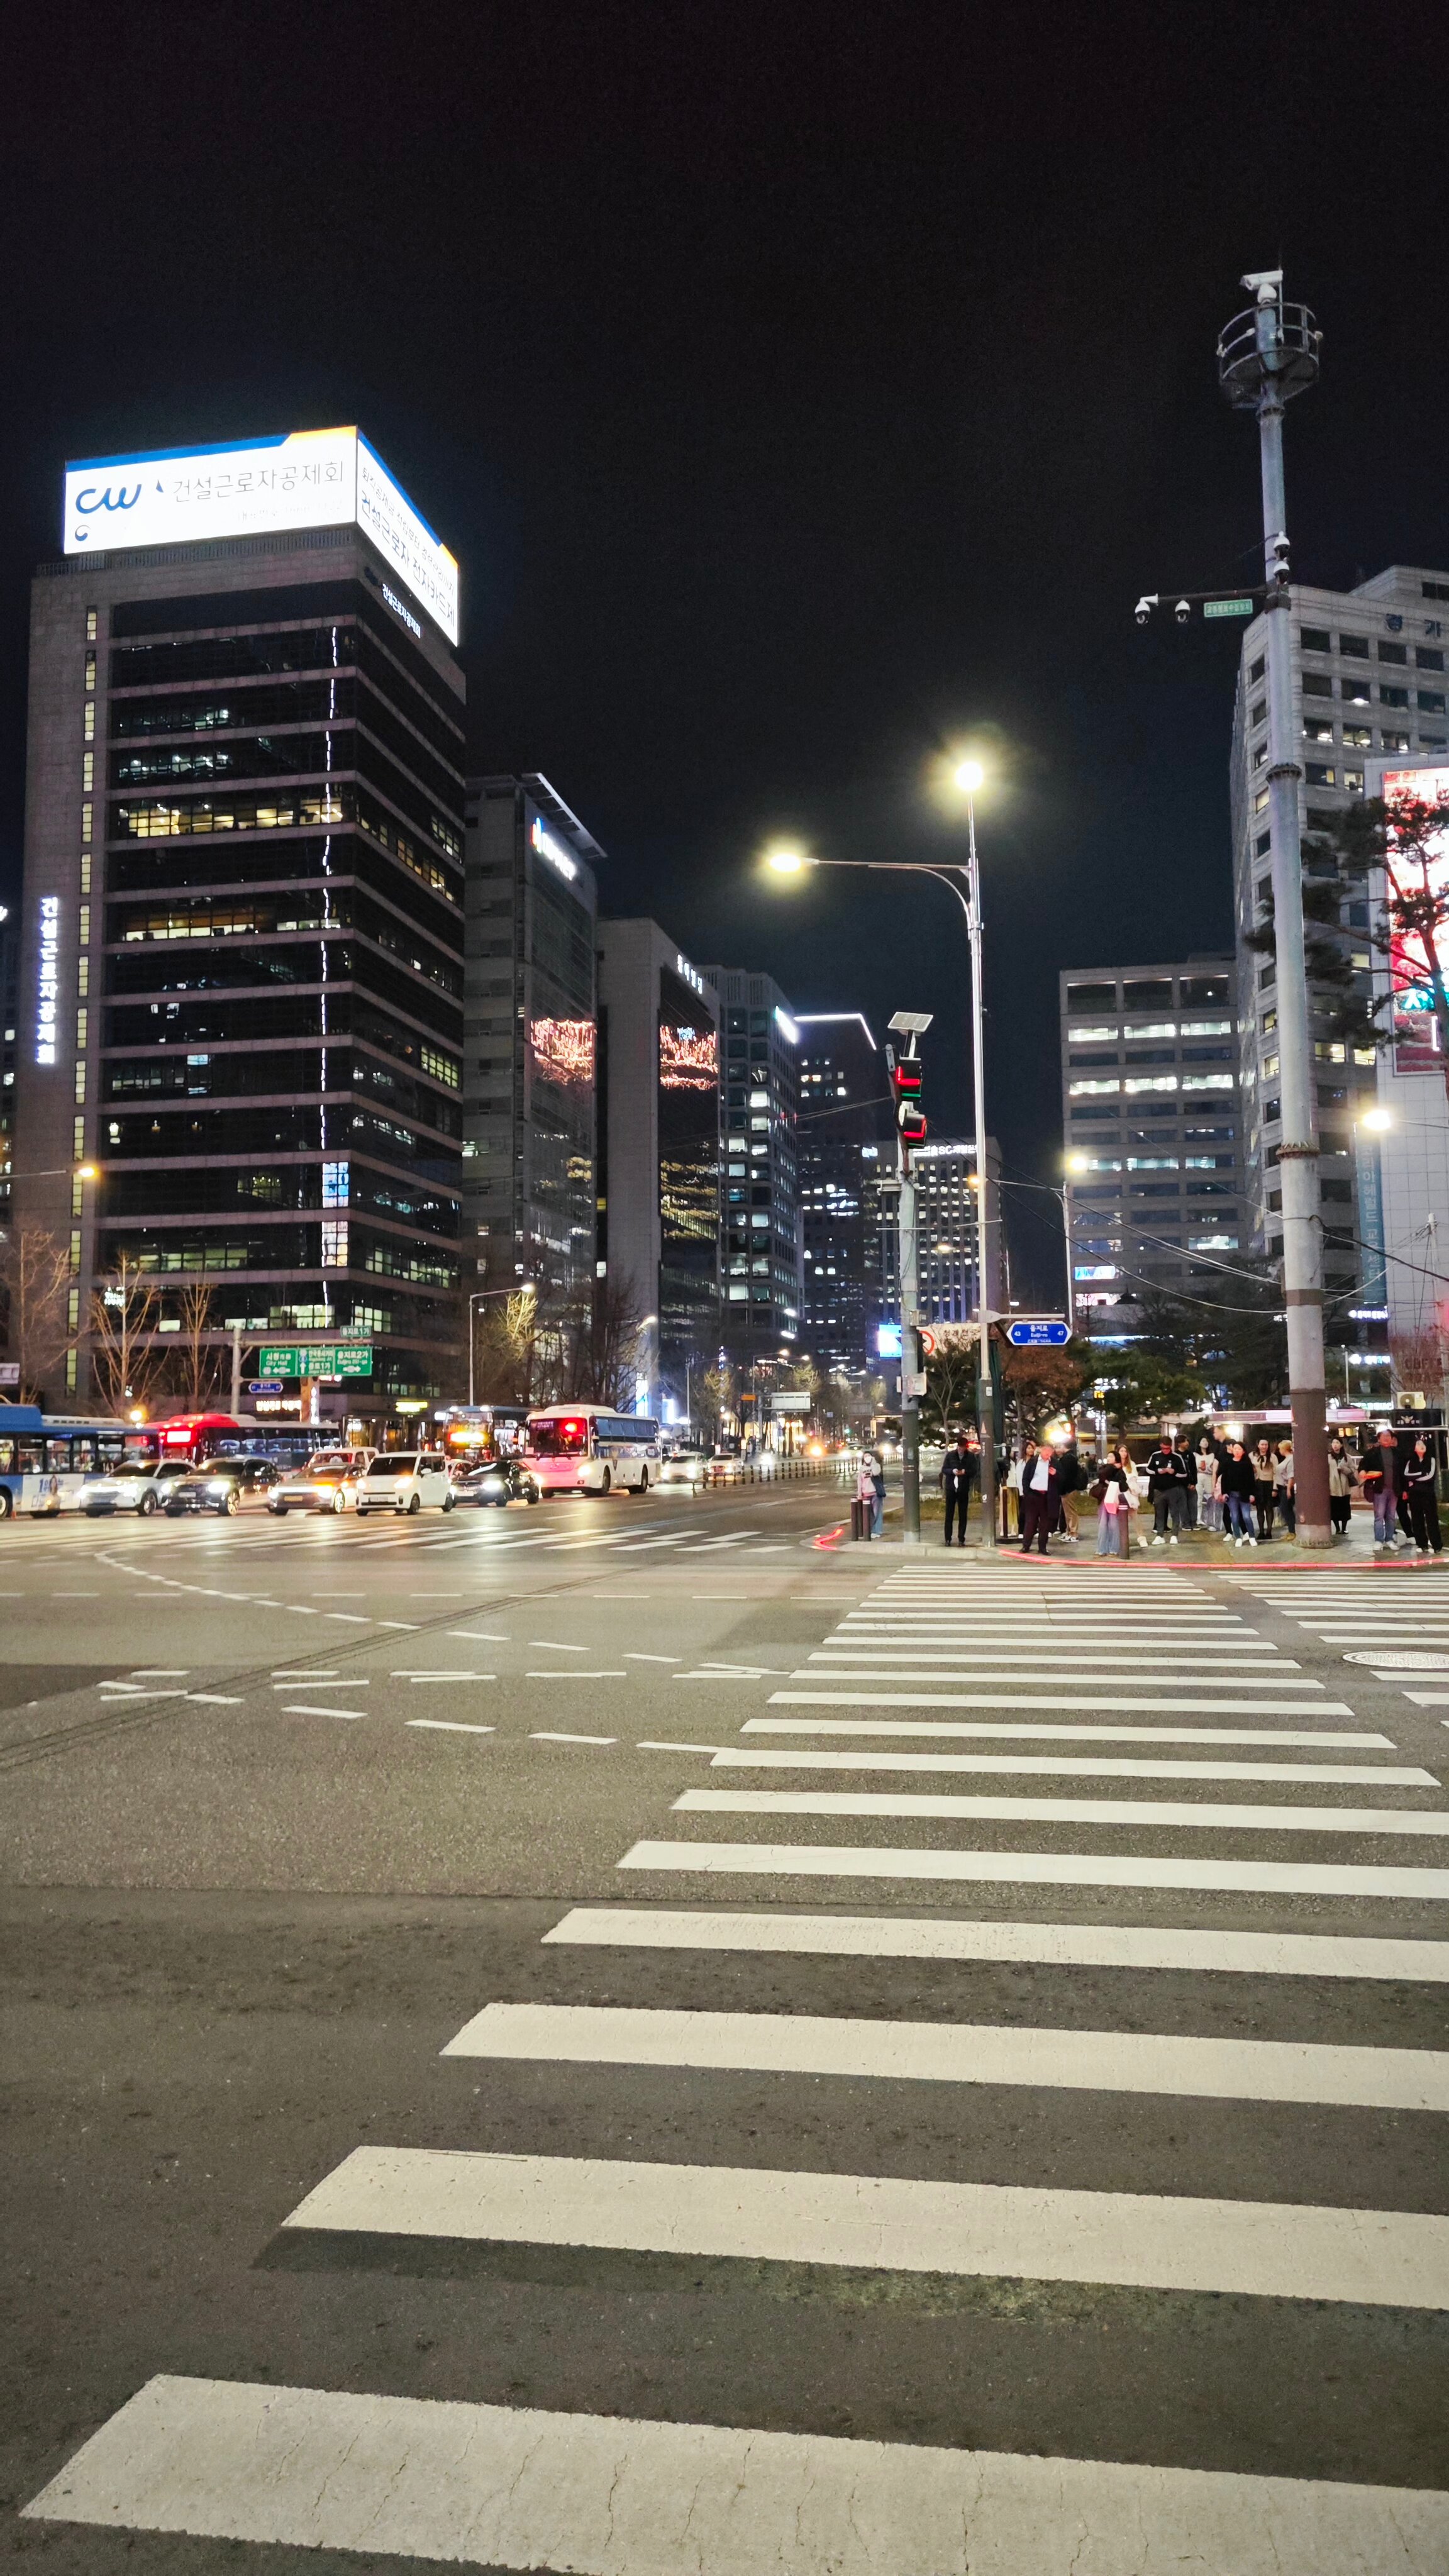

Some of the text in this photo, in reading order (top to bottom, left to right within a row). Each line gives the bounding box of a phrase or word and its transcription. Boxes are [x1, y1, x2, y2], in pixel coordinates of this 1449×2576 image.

[172, 461, 344, 503] 건설근로자공제회
[362, 490, 455, 626] 건설근로자 전자카드제
[382, 583, 421, 639] 건설근로자공제회
